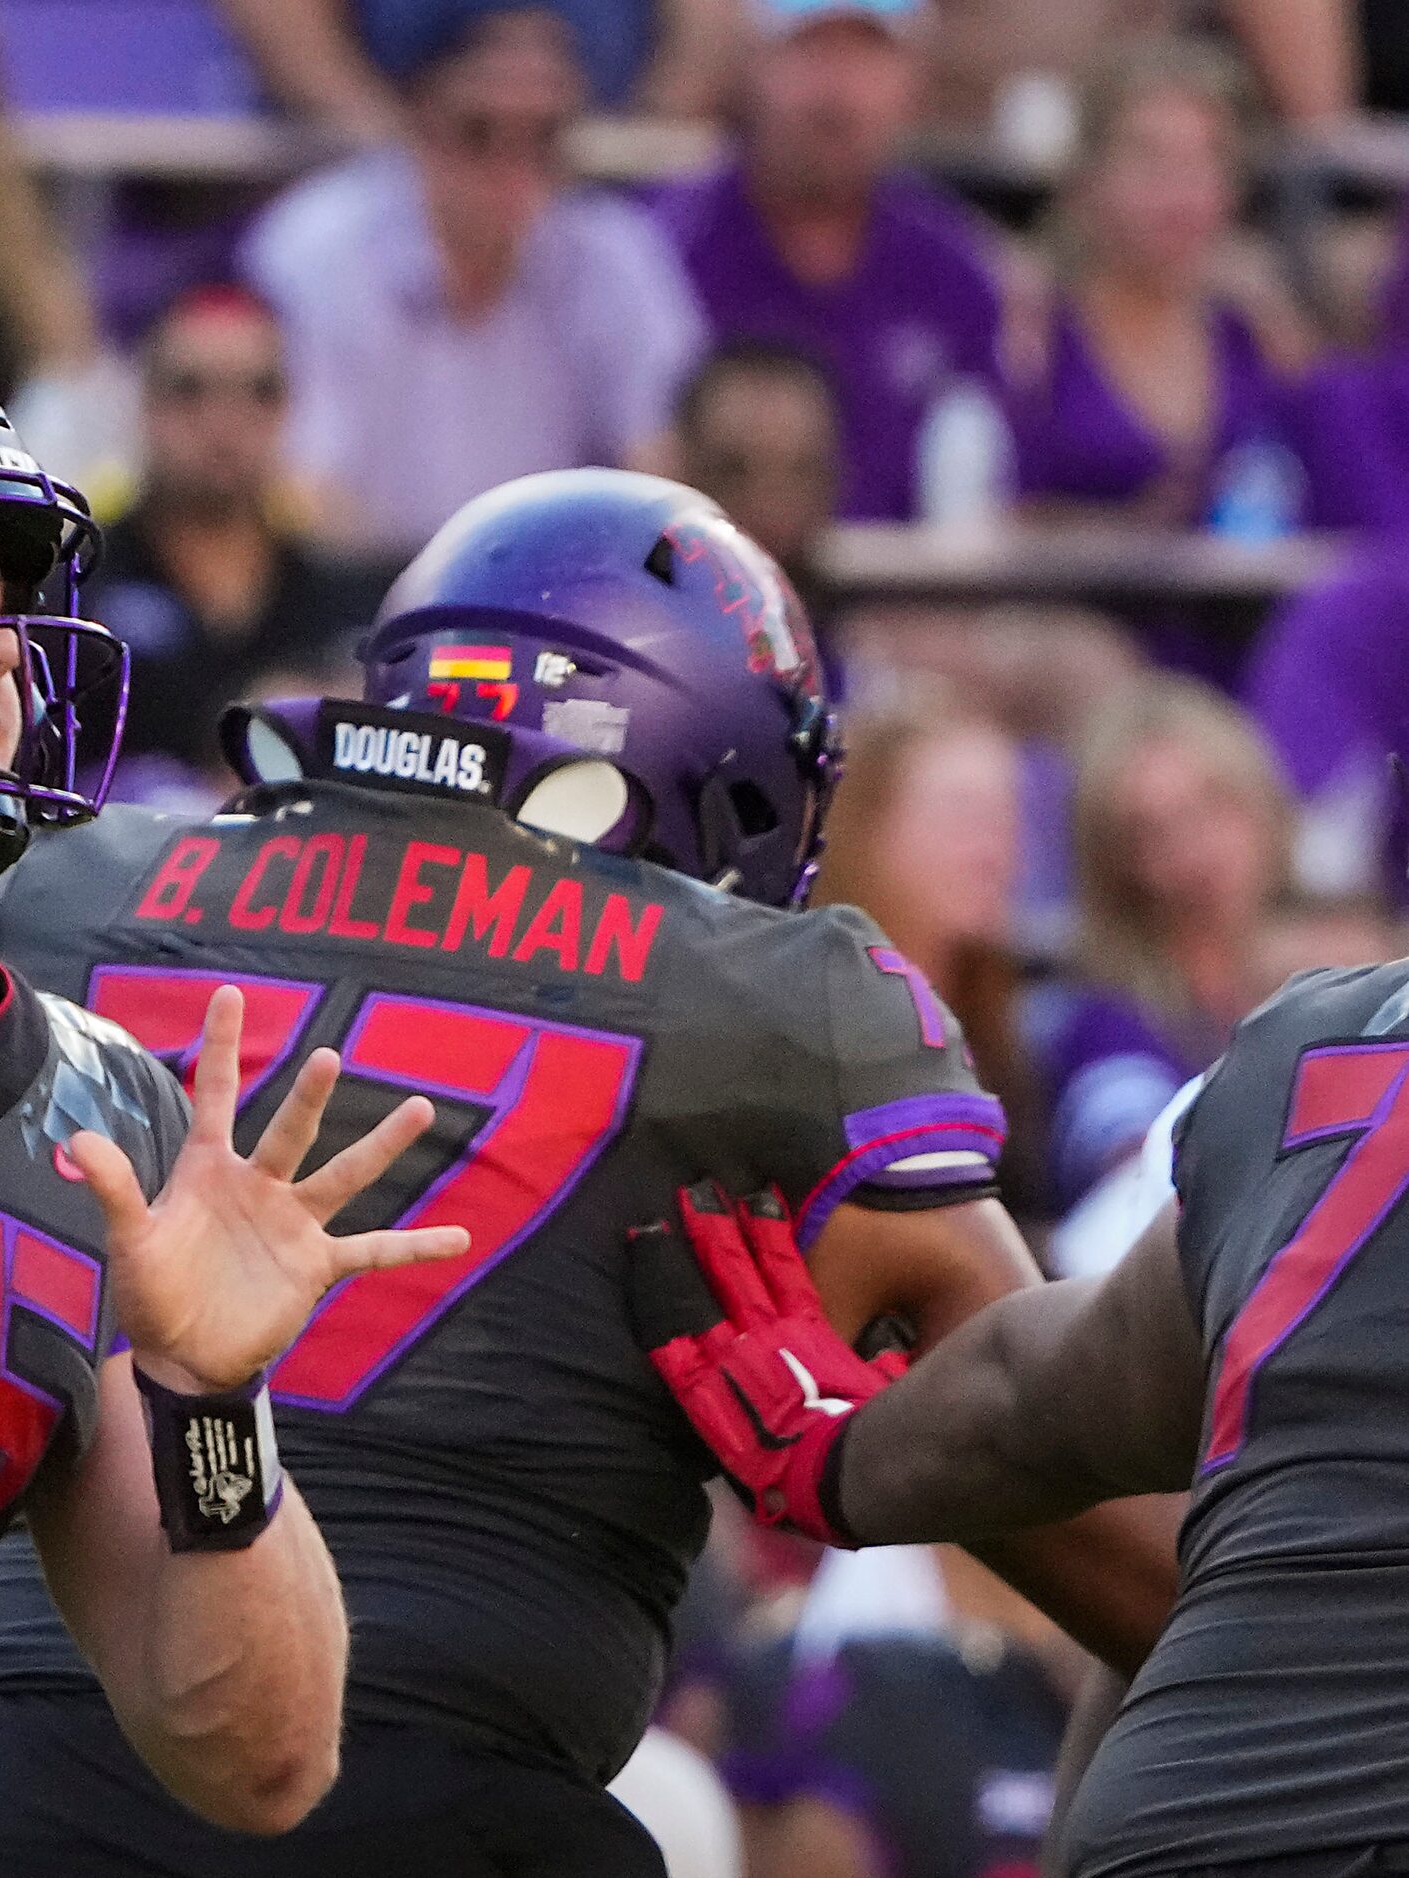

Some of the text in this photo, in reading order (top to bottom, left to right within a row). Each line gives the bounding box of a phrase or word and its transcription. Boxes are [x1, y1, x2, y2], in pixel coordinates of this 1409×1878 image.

[427, 683, 519, 721] 77
[333, 722, 488, 792] DOUGLAS
[135, 833, 664, 982] B. COLEMAN
